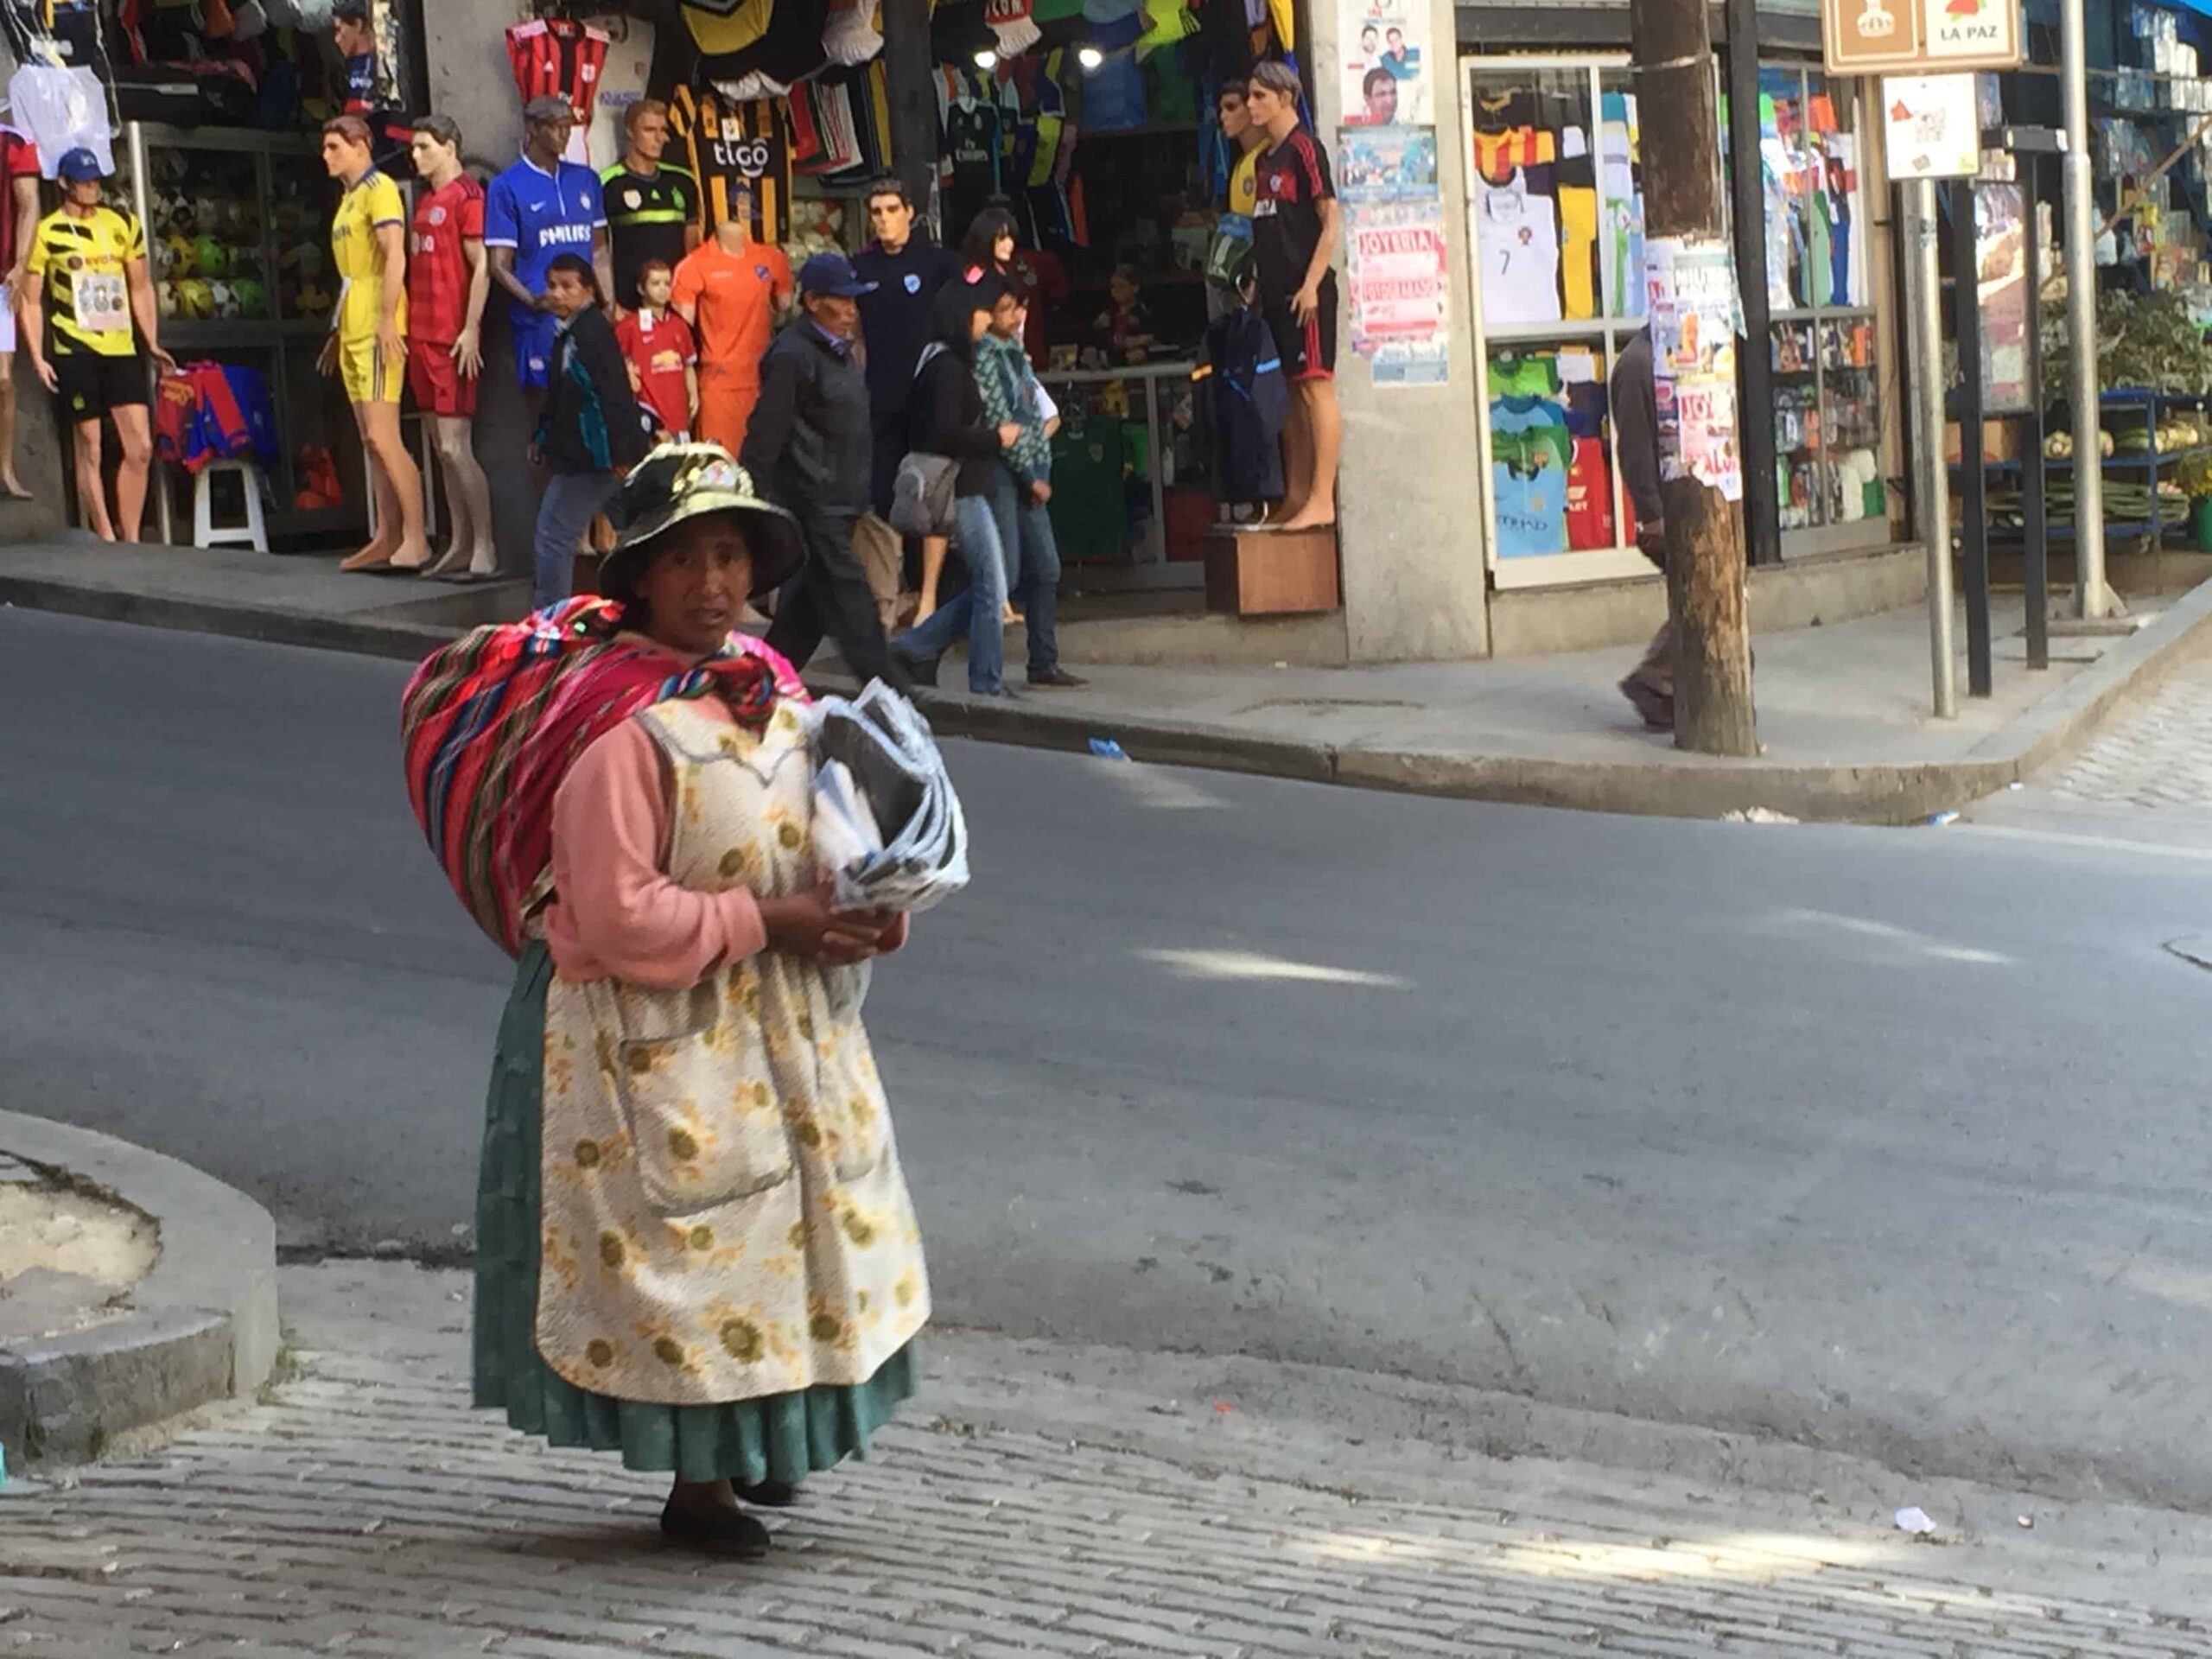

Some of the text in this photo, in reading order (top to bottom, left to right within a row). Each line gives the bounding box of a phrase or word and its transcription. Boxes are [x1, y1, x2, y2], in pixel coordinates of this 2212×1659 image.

[1941, 25, 1998, 41] LA PAZ
[714, 140, 769, 178] tigo
[1359, 230, 1432, 255] JOYERIA
[1499, 250, 1511, 276] 7
